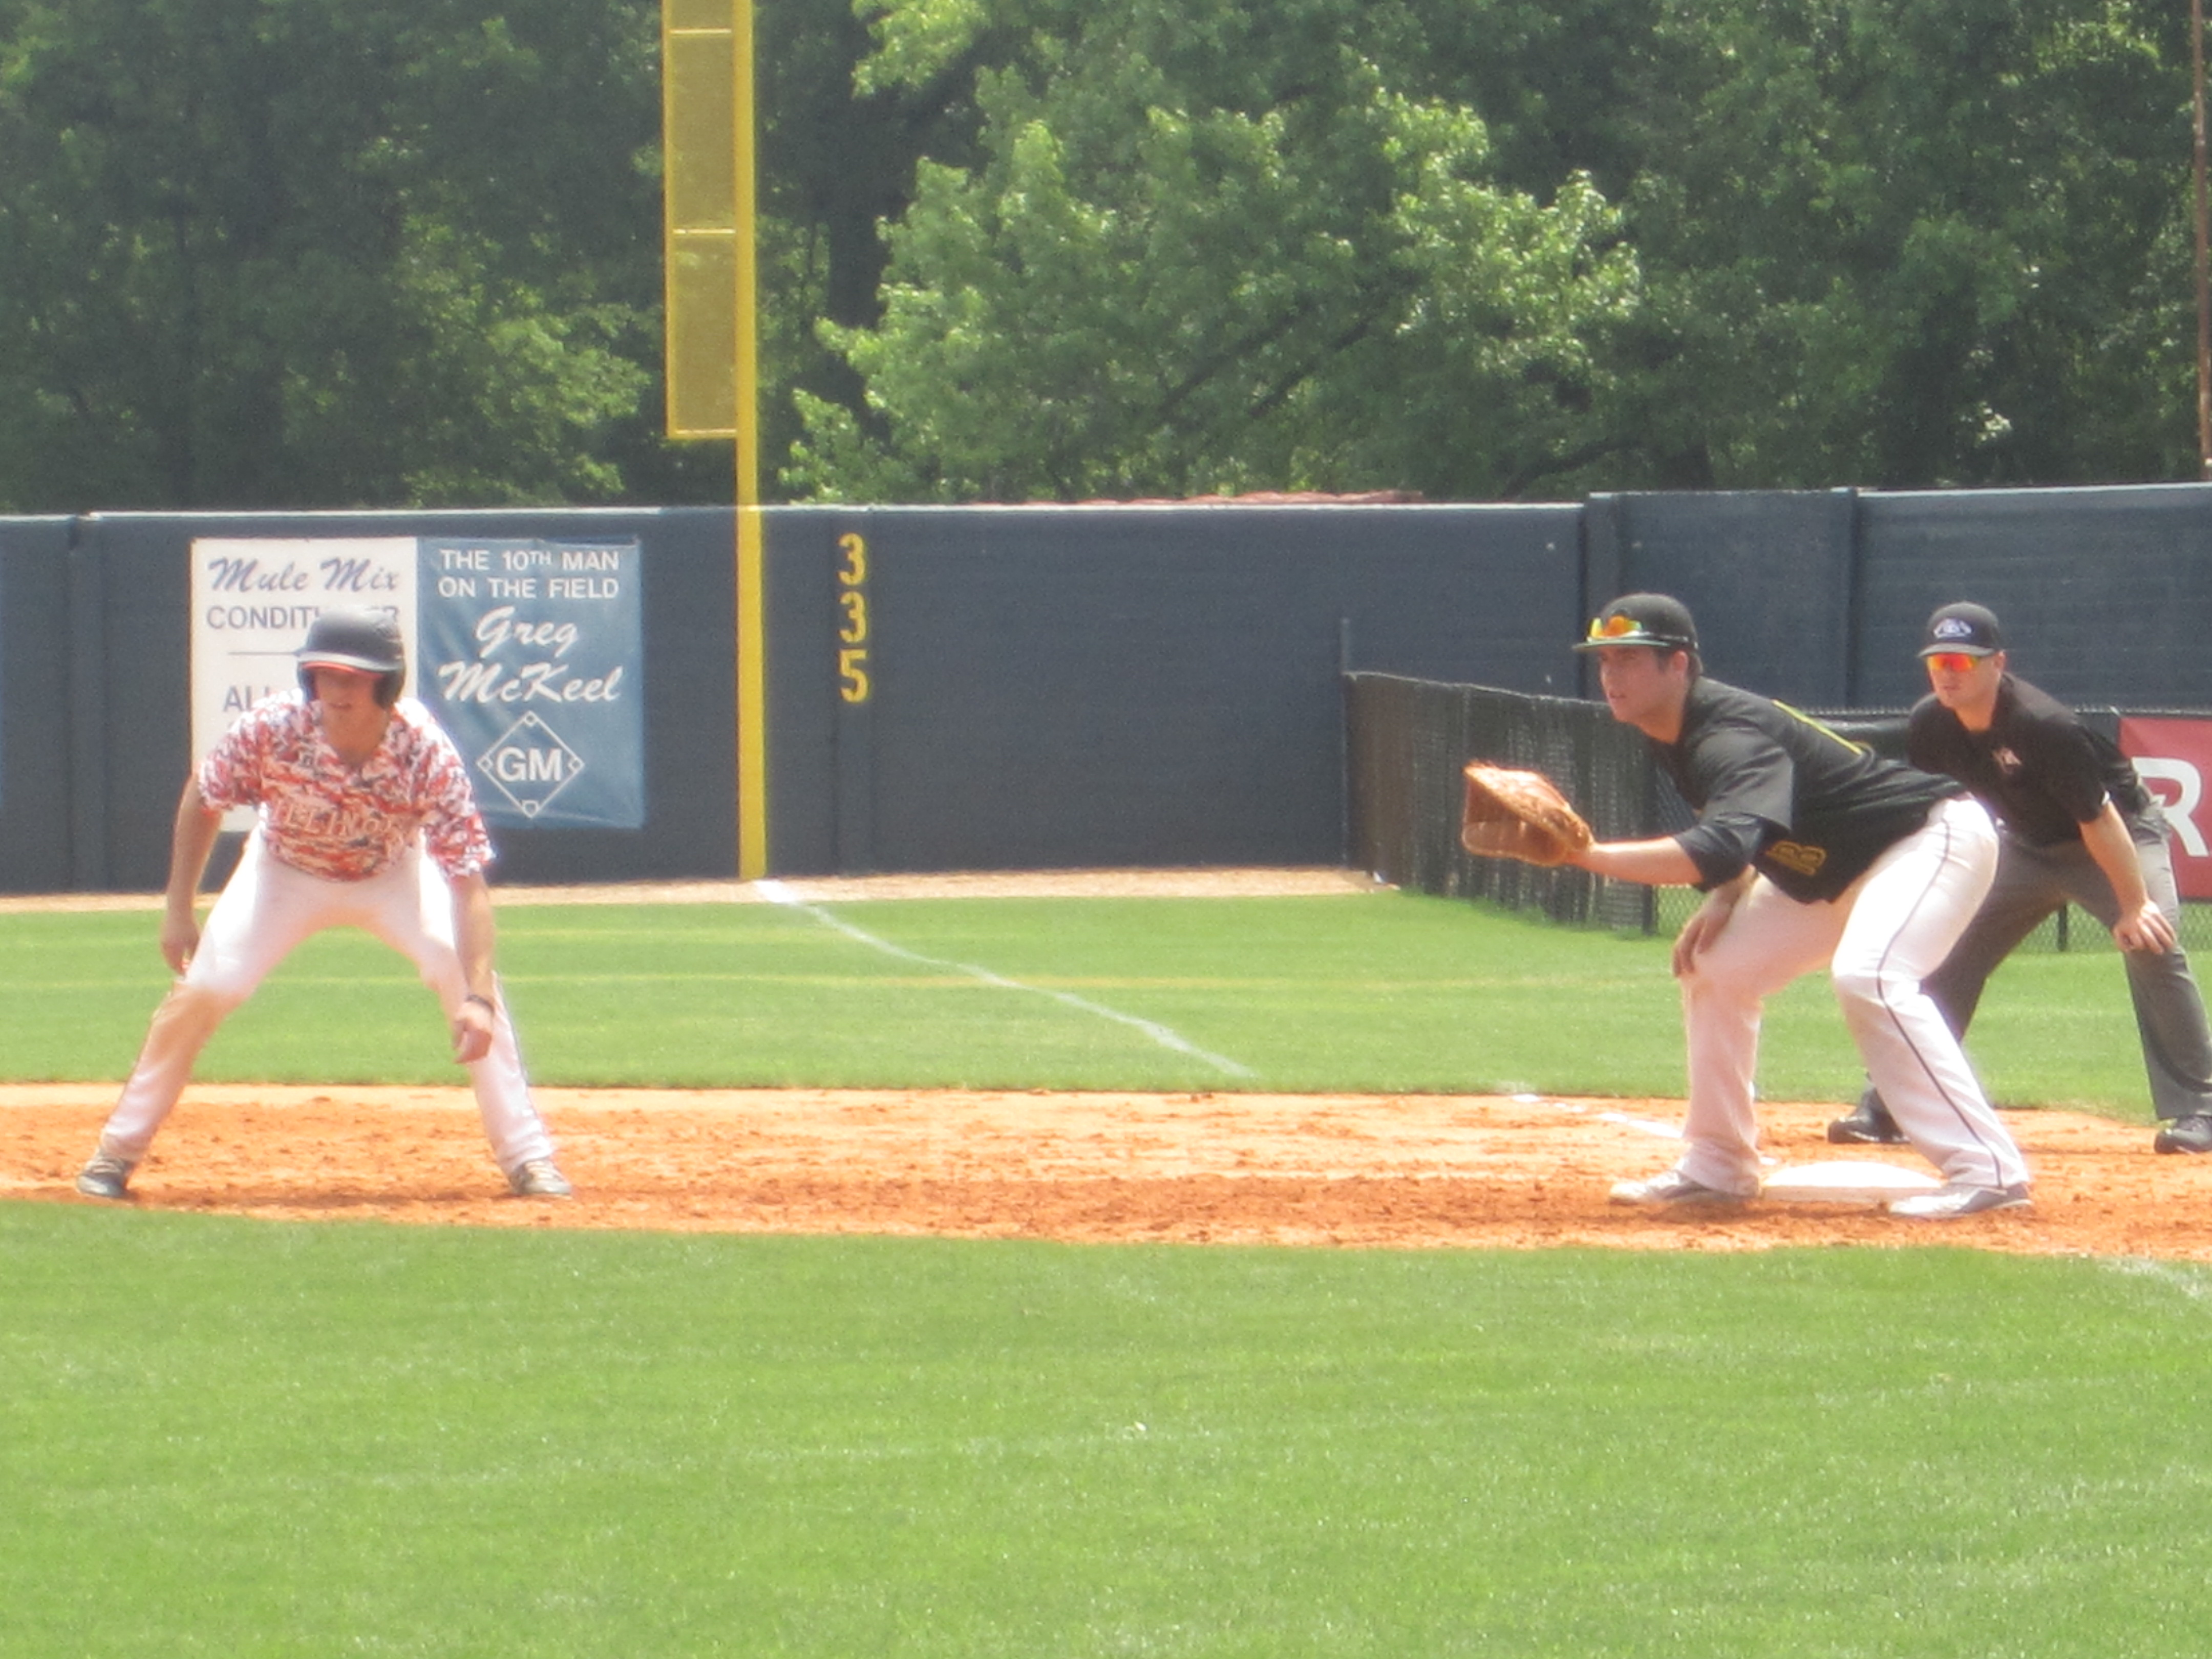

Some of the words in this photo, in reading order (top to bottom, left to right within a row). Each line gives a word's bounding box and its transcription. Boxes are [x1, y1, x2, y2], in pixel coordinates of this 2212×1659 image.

[207, 556, 309, 592] Mule
[320, 556, 399, 592] Mix
[440, 549, 490, 570] THE
[502, 550, 551, 571] 10TH
[563, 551, 619, 571] MAN
[438, 576, 476, 598] ON
[487, 577, 537, 599] THE
[548, 578, 620, 599] FIELD
[475, 605, 578, 658] Greg
[838, 533, 869, 703] 335
[438, 660, 624, 704] McKeel
[496, 746, 562, 782] GM
